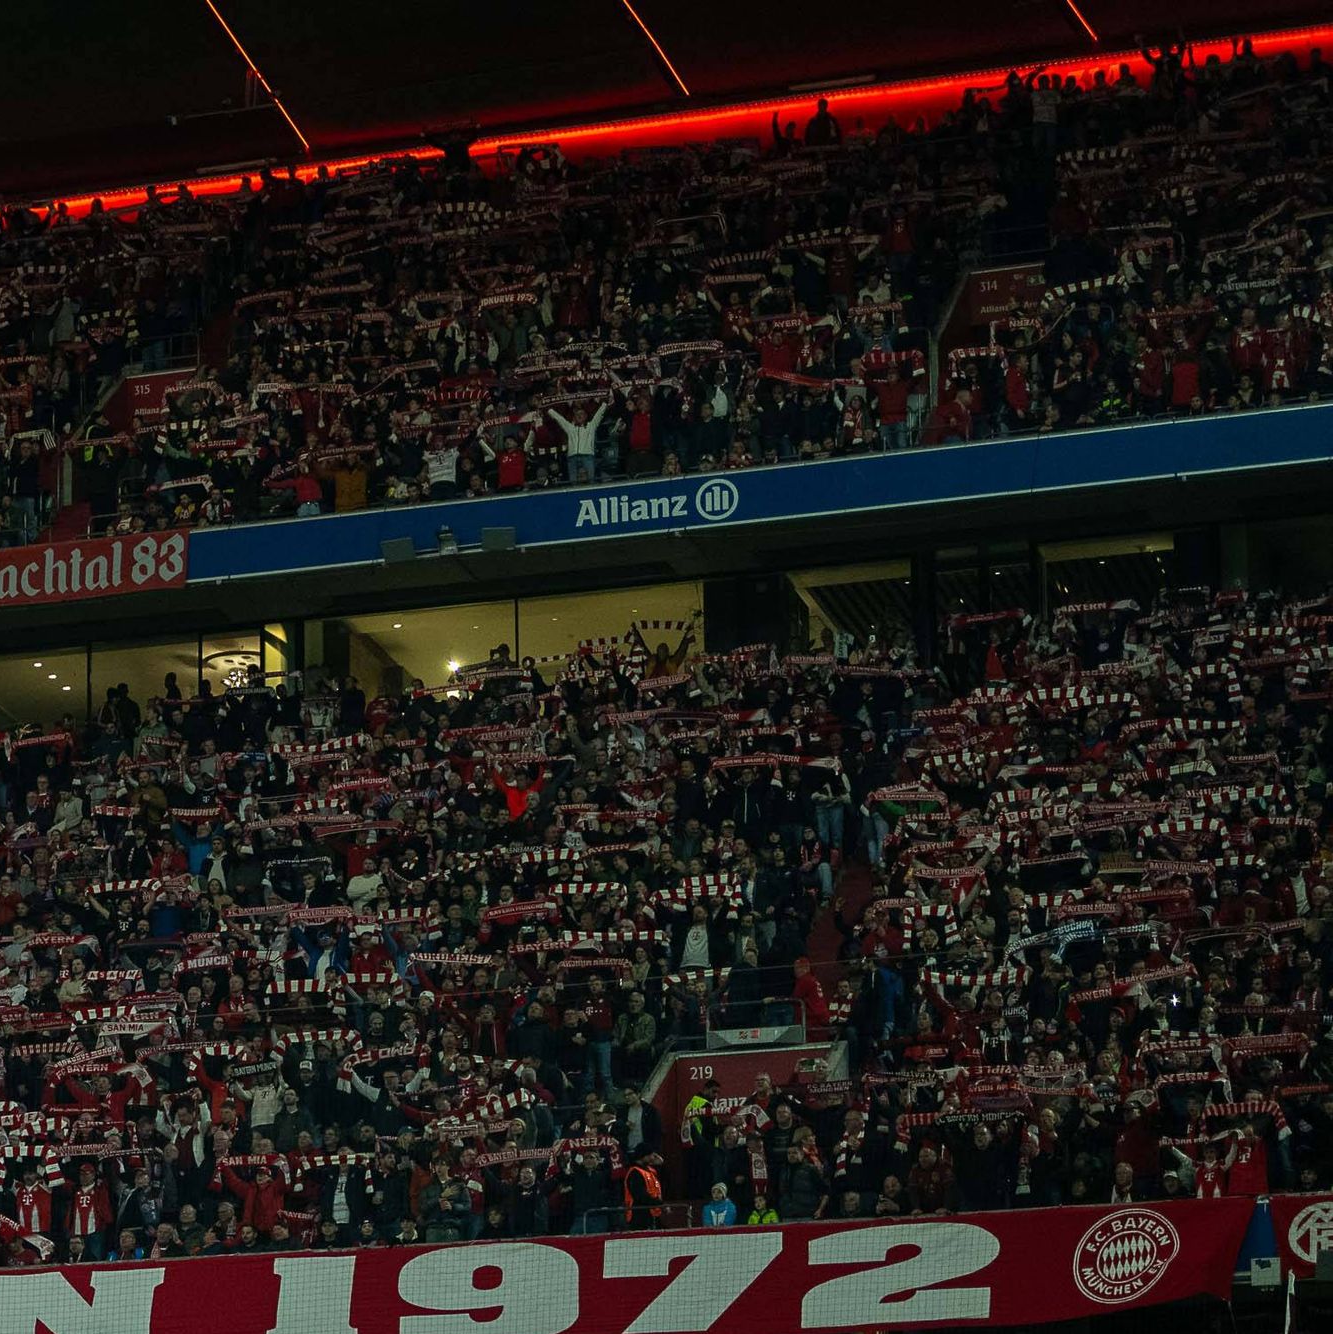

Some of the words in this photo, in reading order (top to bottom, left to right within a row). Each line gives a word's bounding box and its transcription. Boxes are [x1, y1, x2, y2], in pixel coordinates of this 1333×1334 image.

[576, 494, 689, 530] Allianz
[132, 533, 184, 586] 83
[1112, 1216, 1170, 1246] BAYERN
[1081, 1267, 1143, 1296] MÜNCHEN
